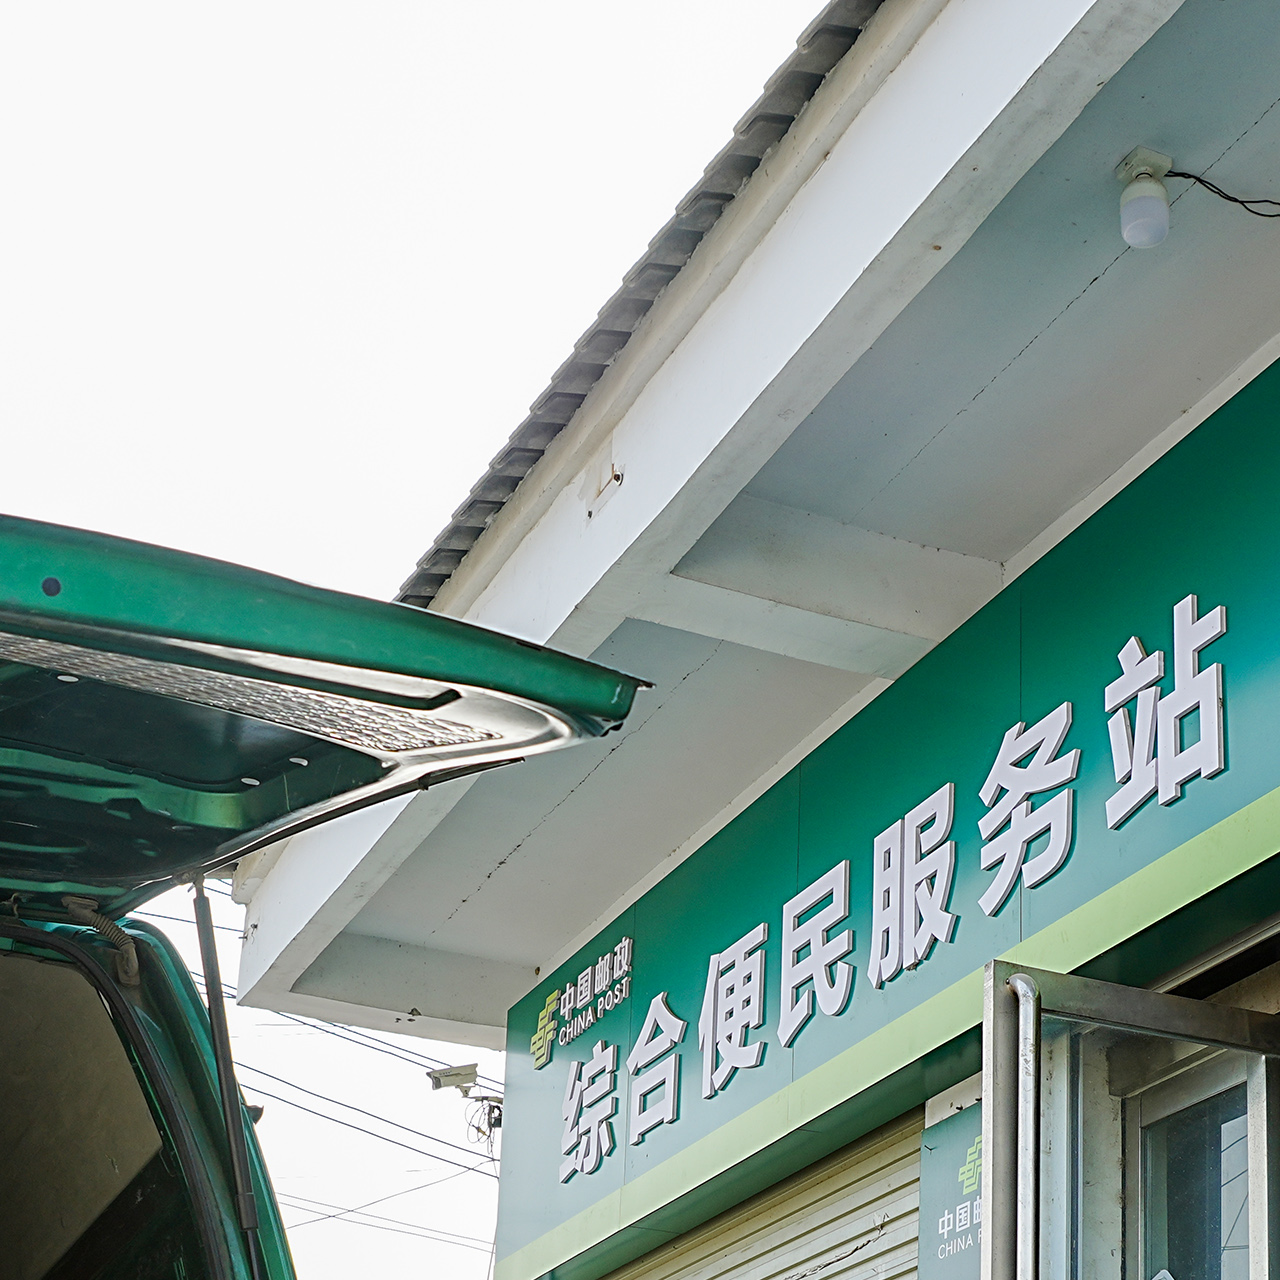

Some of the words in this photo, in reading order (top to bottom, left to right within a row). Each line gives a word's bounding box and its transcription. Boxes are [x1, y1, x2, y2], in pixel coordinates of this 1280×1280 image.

[560, 593, 1227, 1184] 综合便民服务站
[558, 1006, 597, 1046] CHINA
[597, 976, 632, 1019] POST
[559, 936, 633, 1021] 中国邮政
[937, 1233, 974, 1260] CHINA
